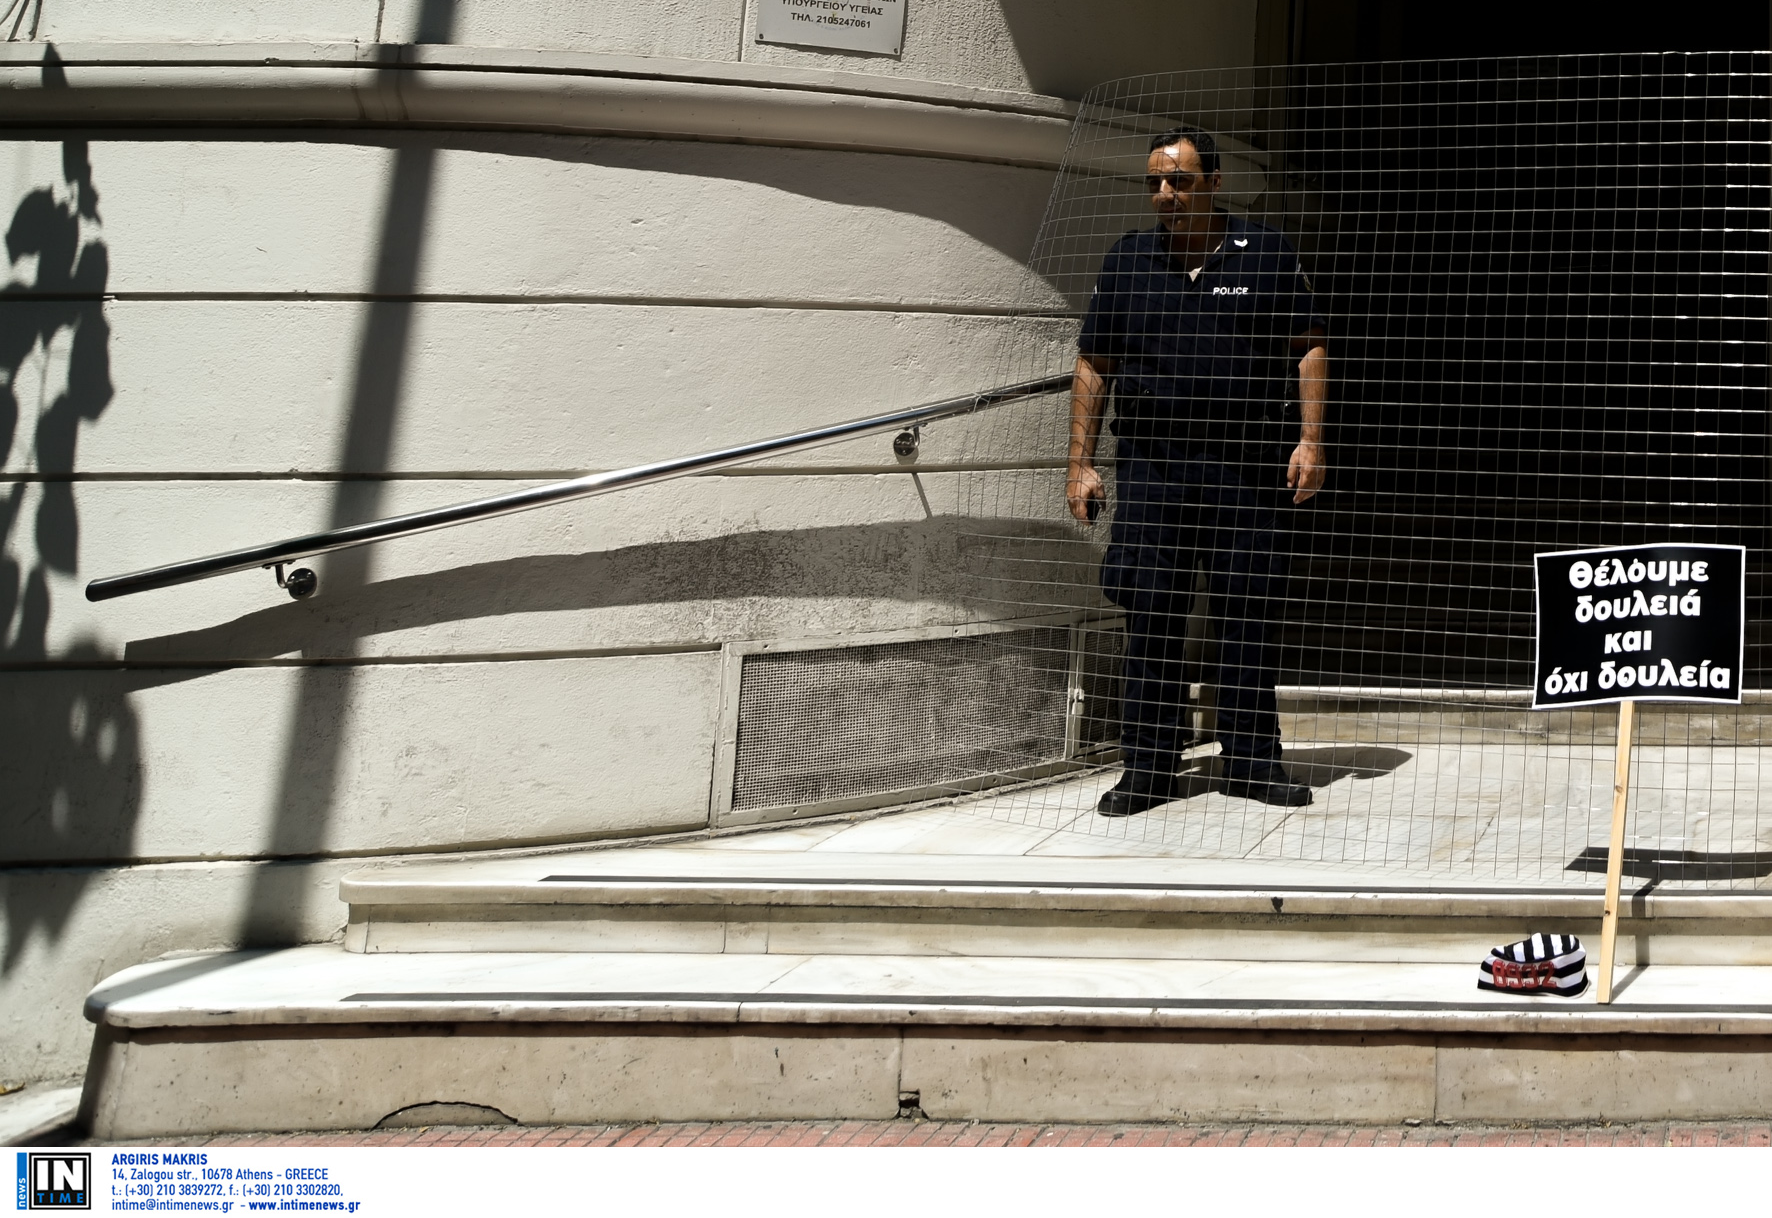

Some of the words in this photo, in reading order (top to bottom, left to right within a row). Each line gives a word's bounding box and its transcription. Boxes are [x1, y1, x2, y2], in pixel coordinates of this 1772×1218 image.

[791, 12, 814, 23] ΤΗΛ.
[816, 15, 871, 29] 2105247061
[849, 4, 884, 16] ΥΓΕΙΑΣ
[1212, 286, 1249, 296] POLICE
[1568, 558, 1709, 589] Θέλουμε
[1575, 589, 1701, 623] δουλειά
[1603, 630, 1652, 654] και
[1544, 667, 1589, 695] όχι
[1597, 658, 1731, 689] δουλεία
